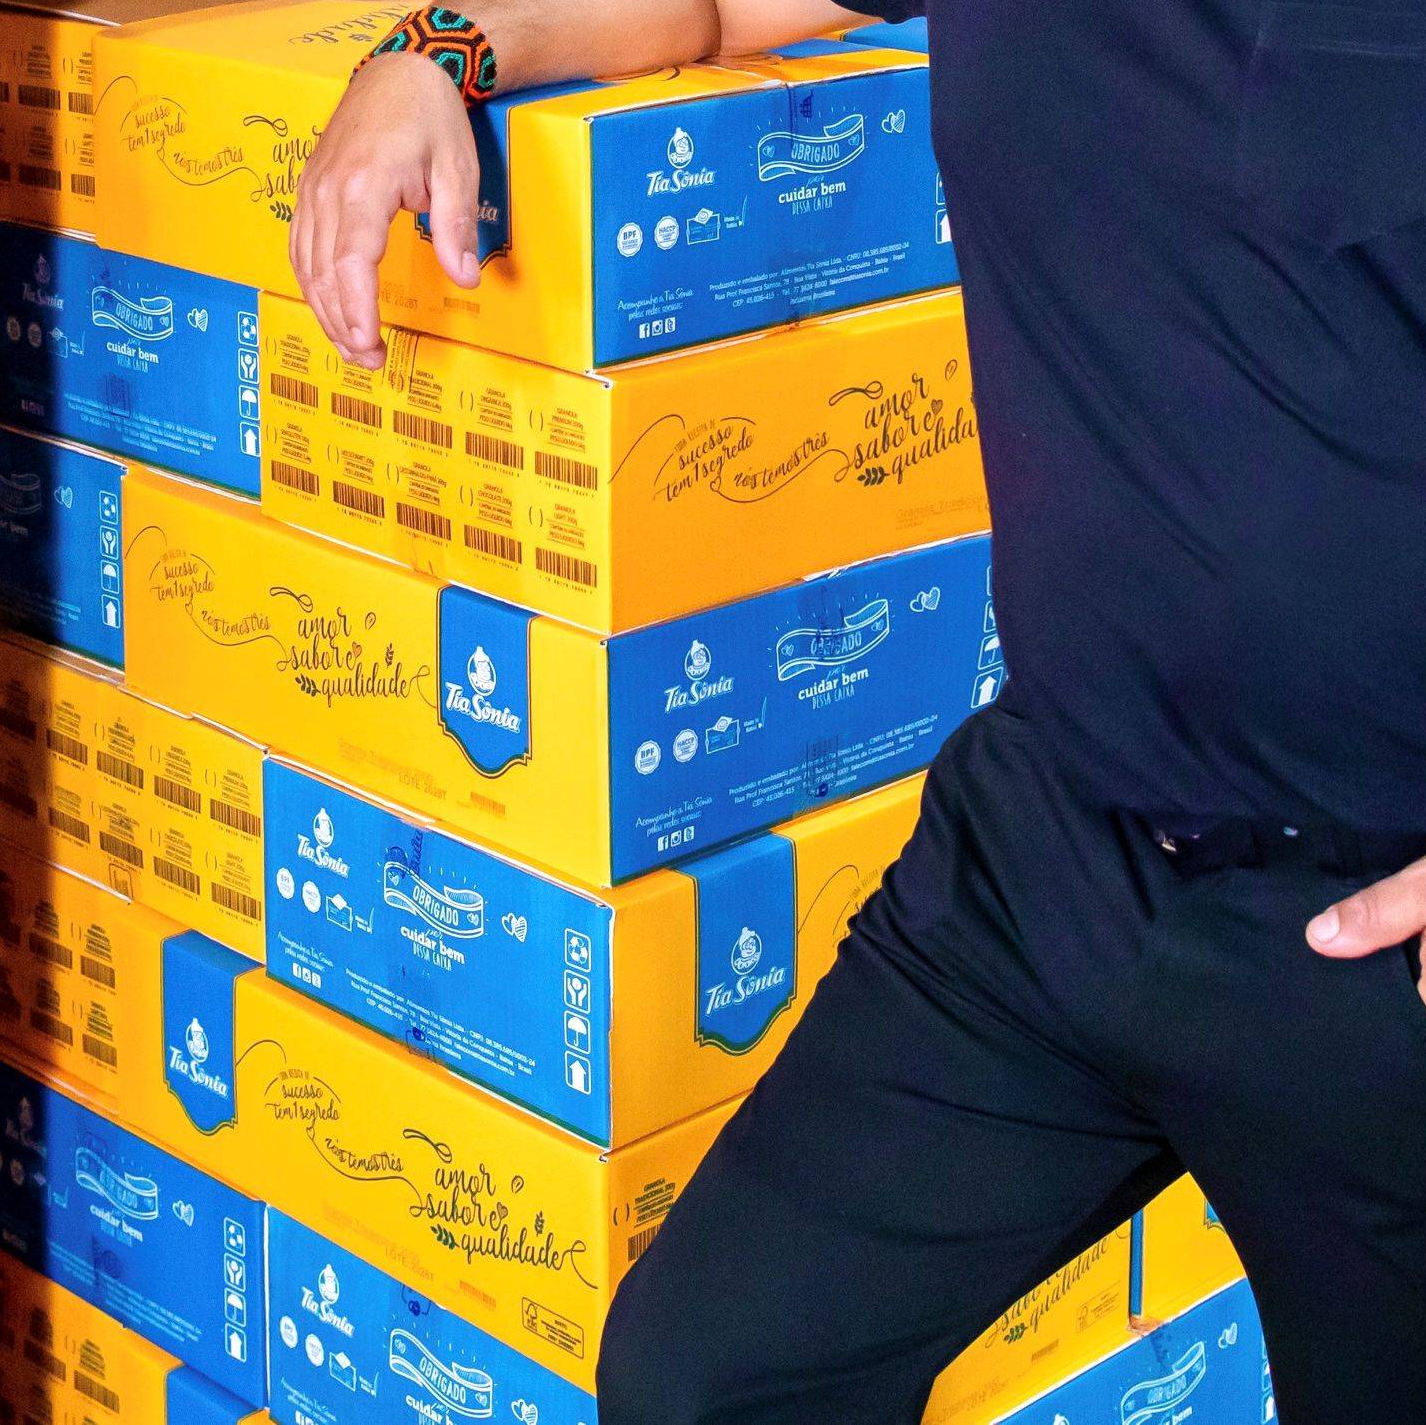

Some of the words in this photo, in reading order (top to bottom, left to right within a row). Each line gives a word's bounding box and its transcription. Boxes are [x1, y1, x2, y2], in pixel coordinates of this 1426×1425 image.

[791, 143, 840, 163] OBRIGADO
[646, 171, 670, 196] Tia
[670, 168, 715, 193] Sônia
[778, 184, 817, 204] cuidar
[821, 180, 846, 195] bem
[623, 230, 637, 240] BPF
[297, 606, 352, 640] amor
[291, 634, 344, 672] sabor
[321, 662, 410, 708] qualidade
[444, 681, 471, 712] Tia
[470, 695, 521, 734] Sônia
[297, 834, 316, 862] Tia
[314, 846, 349, 878] Sônia
[411, 885, 459, 926] OBRIGADO
[400, 926, 438, 951] cuidar
[439, 940, 465, 965] bem
[705, 982, 733, 1017] Tia
[733, 966, 785, 1005] Sônia
